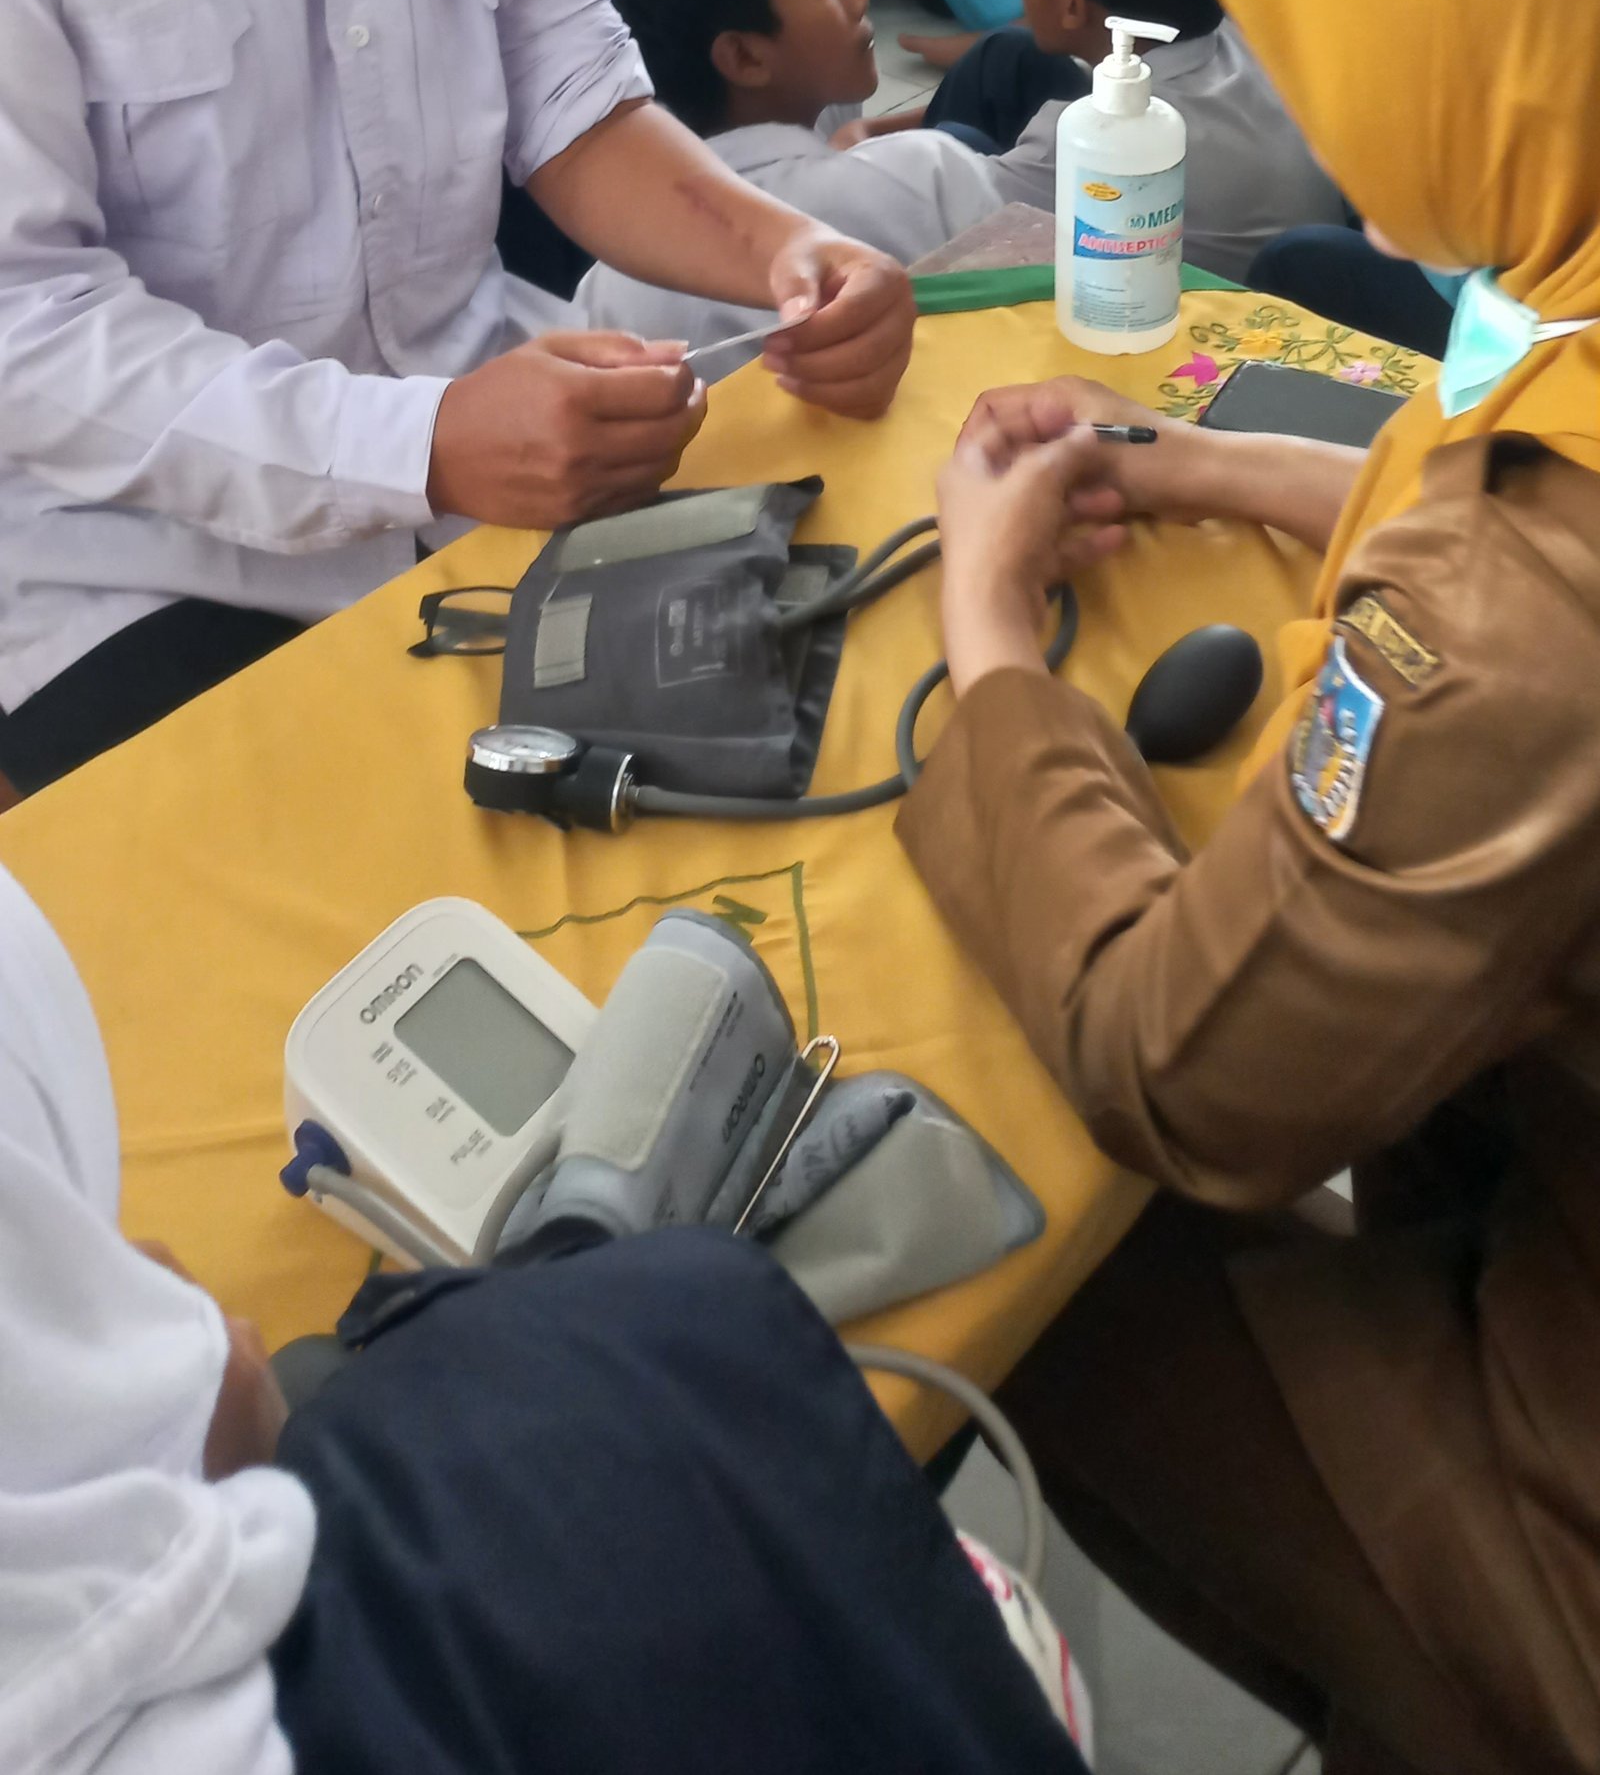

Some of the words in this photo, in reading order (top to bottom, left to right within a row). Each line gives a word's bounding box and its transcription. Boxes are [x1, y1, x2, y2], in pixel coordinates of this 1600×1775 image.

[1079, 233, 1168, 253] ANTISEPTIC
[360, 963, 424, 1024] OMRON
[387, 1058, 411, 1084] SYS
[425, 1096, 450, 1120] DIA
[450, 1129, 485, 1164] PULSE
